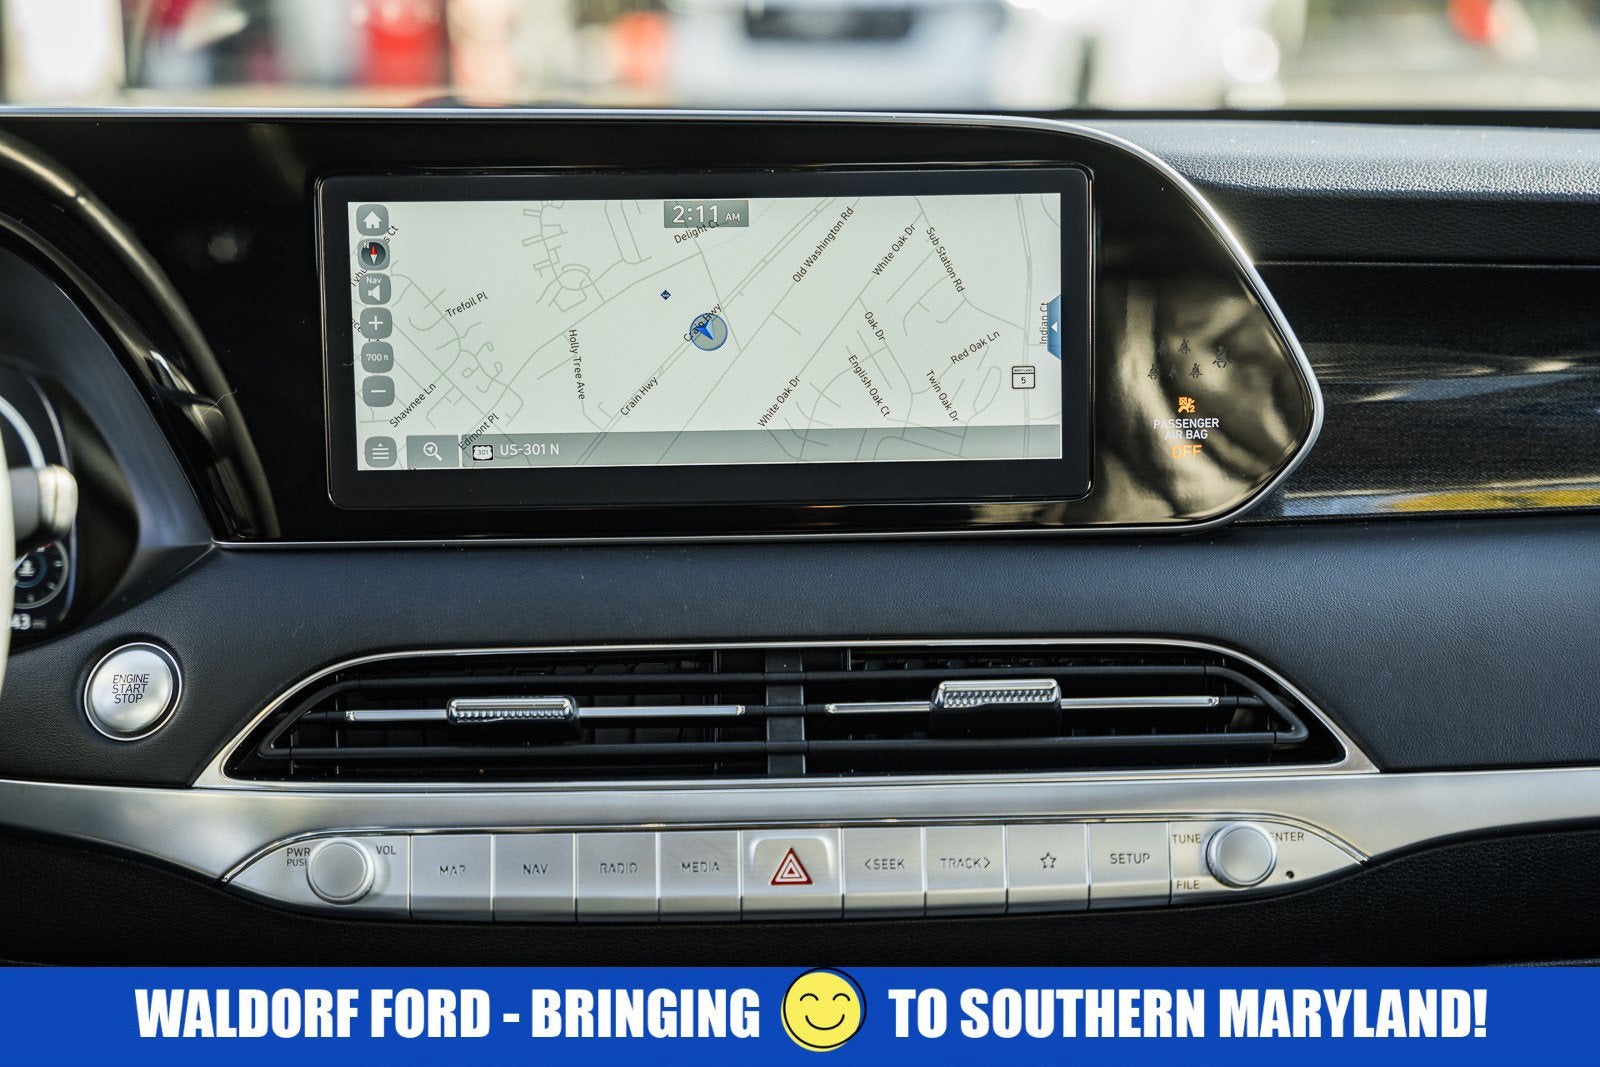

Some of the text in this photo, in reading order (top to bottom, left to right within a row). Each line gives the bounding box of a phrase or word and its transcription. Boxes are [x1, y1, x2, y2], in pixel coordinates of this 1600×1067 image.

[672, 204, 740, 224] 2:11 AM
[386, 224, 399, 237] Ct
[673, 225, 707, 244] Delight
[364, 241, 370, 249] N
[792, 206, 854, 283] Old Washington Rd
[872, 223, 916, 277] White Oak Dr
[926, 227, 966, 293] Sub Station Rd
[366, 276, 382, 284] Nav
[445, 291, 488, 318] Trefoil Pl
[683, 303, 722, 342] Crain Hwy
[864, 311, 886, 342] Oak Dr
[1039, 302, 1049, 344] Indian Ct
[950, 330, 1001, 364] Red Oak Ln
[366, 353, 382, 361] 700
[568, 329, 585, 400] Holly Tree Ave
[847, 354, 891, 418] English Oak Ct
[1021, 376, 1027, 385] 5
[620, 376, 658, 417] Crain Hwy
[758, 375, 800, 427] White Oak Dr
[925, 369, 960, 423] Twin Oak Dr
[389, 382, 437, 428] Shawnee Ln
[1153, 417, 1220, 429] PASSENGER
[459, 412, 500, 451] Edmont Pl
[1164, 429, 1208, 440] AIR BAG
[478, 448, 489, 456] 301
[500, 443, 560, 456] US-301 N
[1172, 444, 1202, 459] OFF
[113, 673, 150, 684] ENGINE
[112, 683, 148, 694] START
[114, 693, 143, 704] STOP
[1172, 833, 1202, 844] TUNE
[287, 847, 311, 857] PWR
[376, 845, 397, 855] VOL
[873, 858, 905, 870] SEEK
[940, 857, 981, 869] TRACK
[1110, 852, 1151, 865] SETUP
[439, 864, 466, 877] MAP
[522, 863, 548, 875] NAV
[599, 862, 638, 874] RADIO
[681, 861, 720, 873] MEDIA
[1176, 879, 1200, 890] FILE
